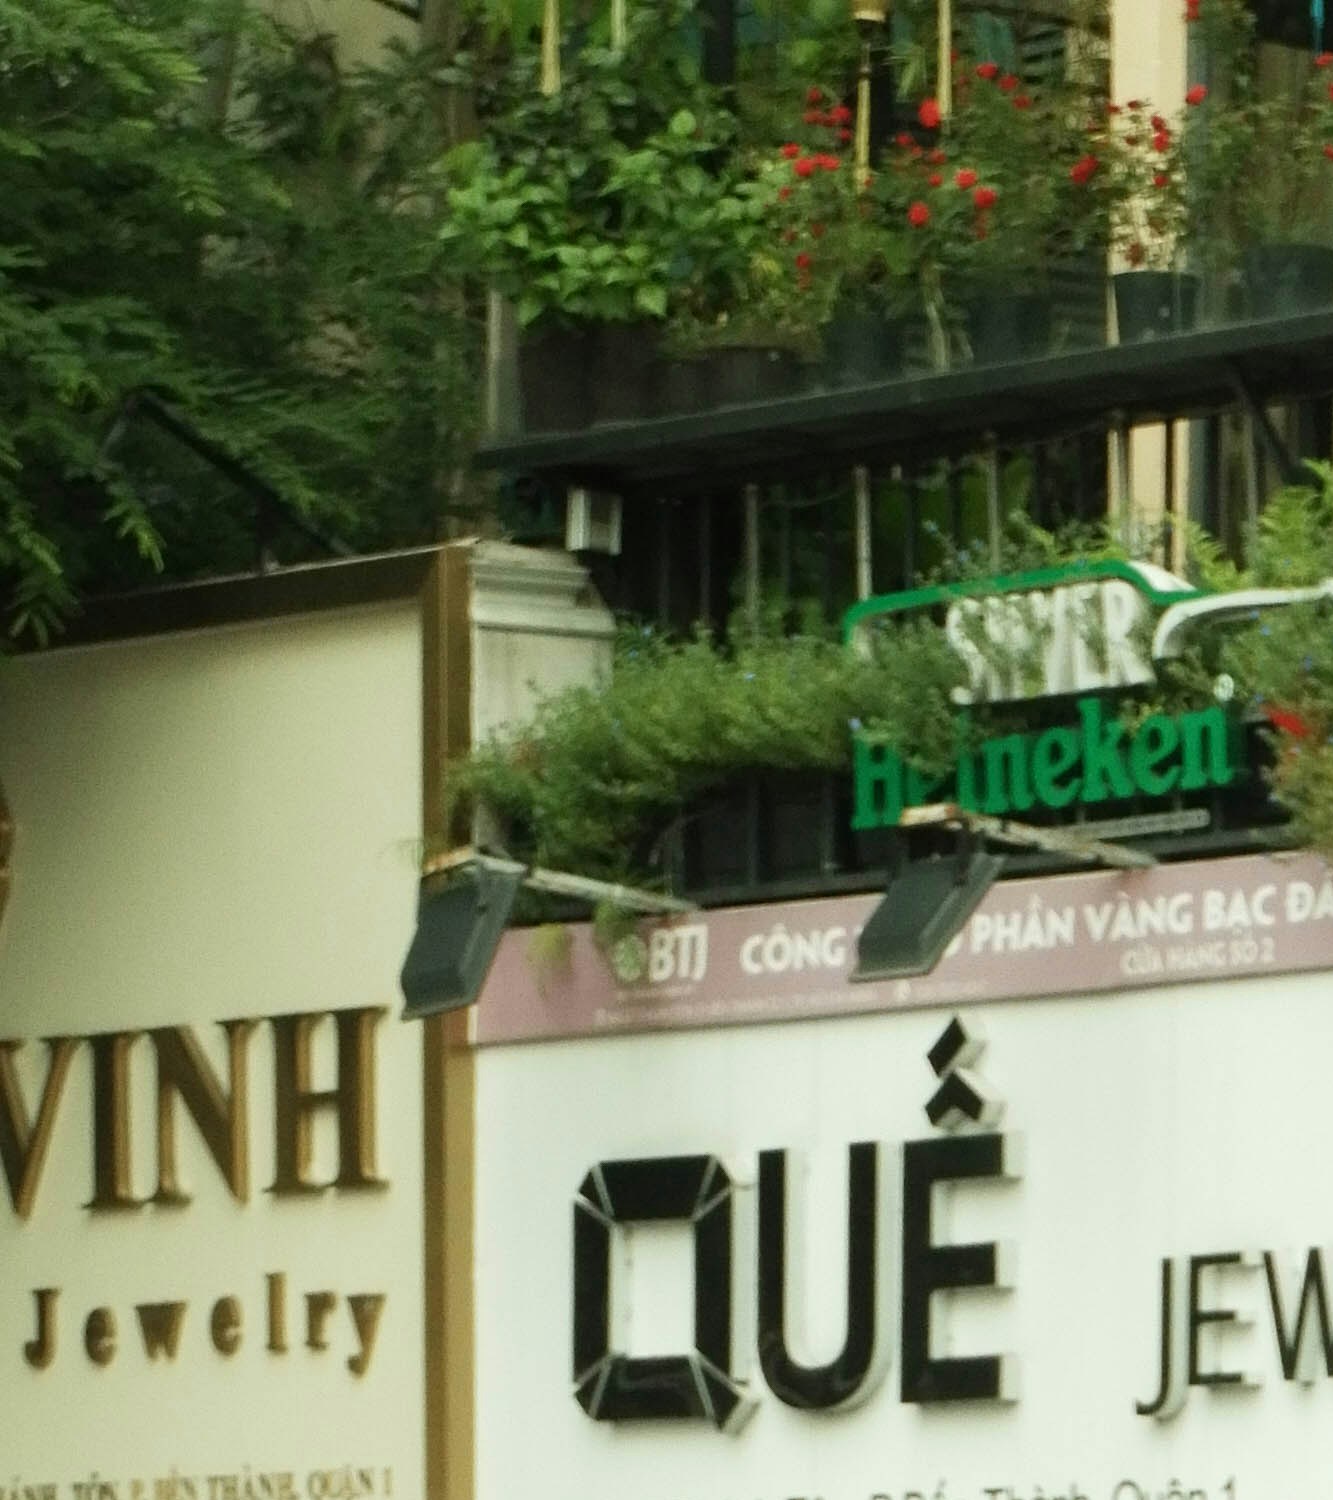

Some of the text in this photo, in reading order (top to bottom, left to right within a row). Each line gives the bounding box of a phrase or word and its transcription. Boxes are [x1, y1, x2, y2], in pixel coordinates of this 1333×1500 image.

[739, 923, 847, 975] CÔNG
[1083, 891, 1194, 944] VÀNG
[0, 1004, 391, 1222] VINH
[25, 1272, 388, 1378] Jewelry
